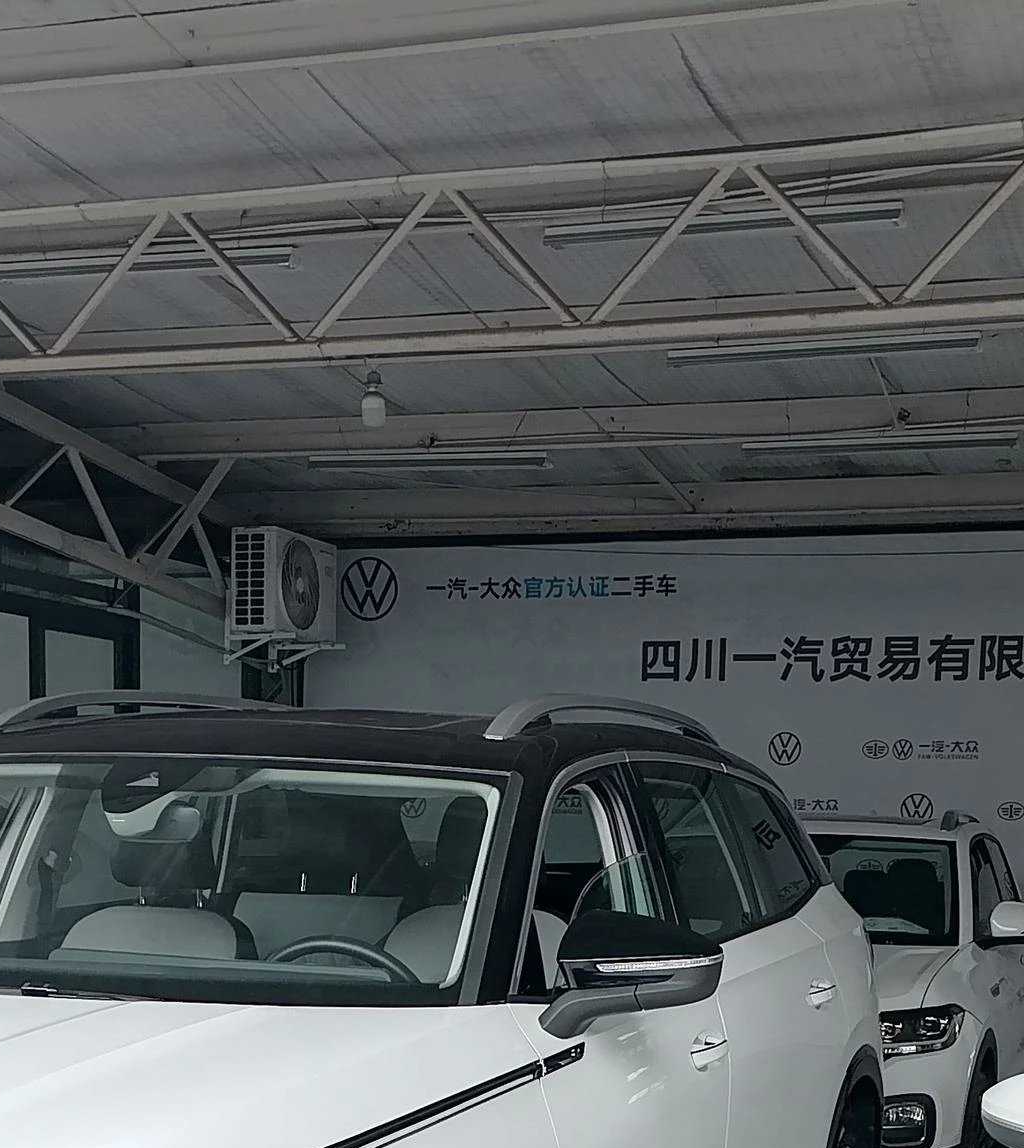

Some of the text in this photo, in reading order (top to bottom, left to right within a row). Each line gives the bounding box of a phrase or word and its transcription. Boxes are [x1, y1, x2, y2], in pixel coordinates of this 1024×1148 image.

[425, 574, 678, 600] 一汽-大众官方认证二手车
[641, 634, 1024, 683] 四川一汽贸易有限
[918, 740, 980, 754] 一汽-大众
[793, 798, 840, 812] 汽-大众
